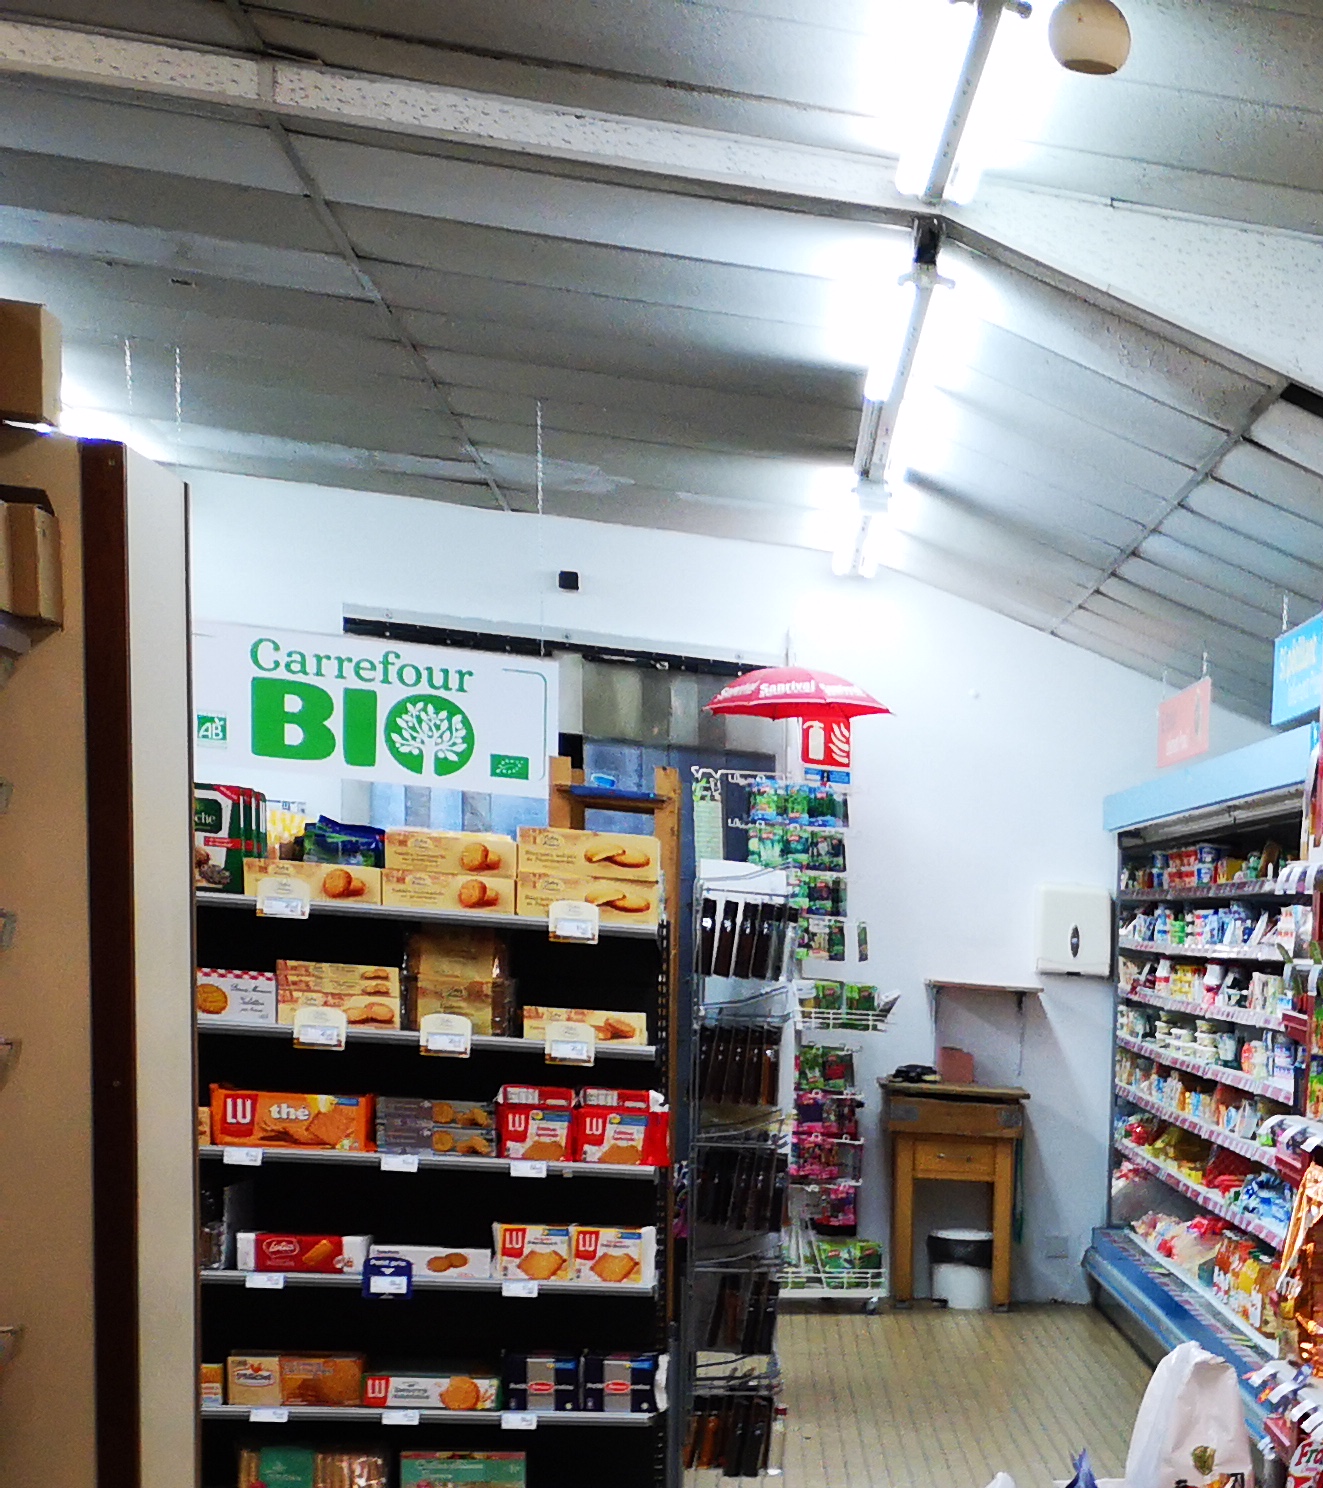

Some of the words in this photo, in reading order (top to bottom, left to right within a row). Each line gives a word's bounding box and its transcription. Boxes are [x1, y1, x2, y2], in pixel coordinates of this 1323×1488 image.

[250, 637, 474, 693] Carrefour
[251, 676, 476, 777] BIO
[225, 1097, 253, 1125] LU
[507, 1112, 525, 1132] LU
[585, 1117, 603, 1136] LU
[504, 1230, 524, 1250] LU
[578, 1232, 597, 1252] LU
[366, 1377, 385, 1398] LU
